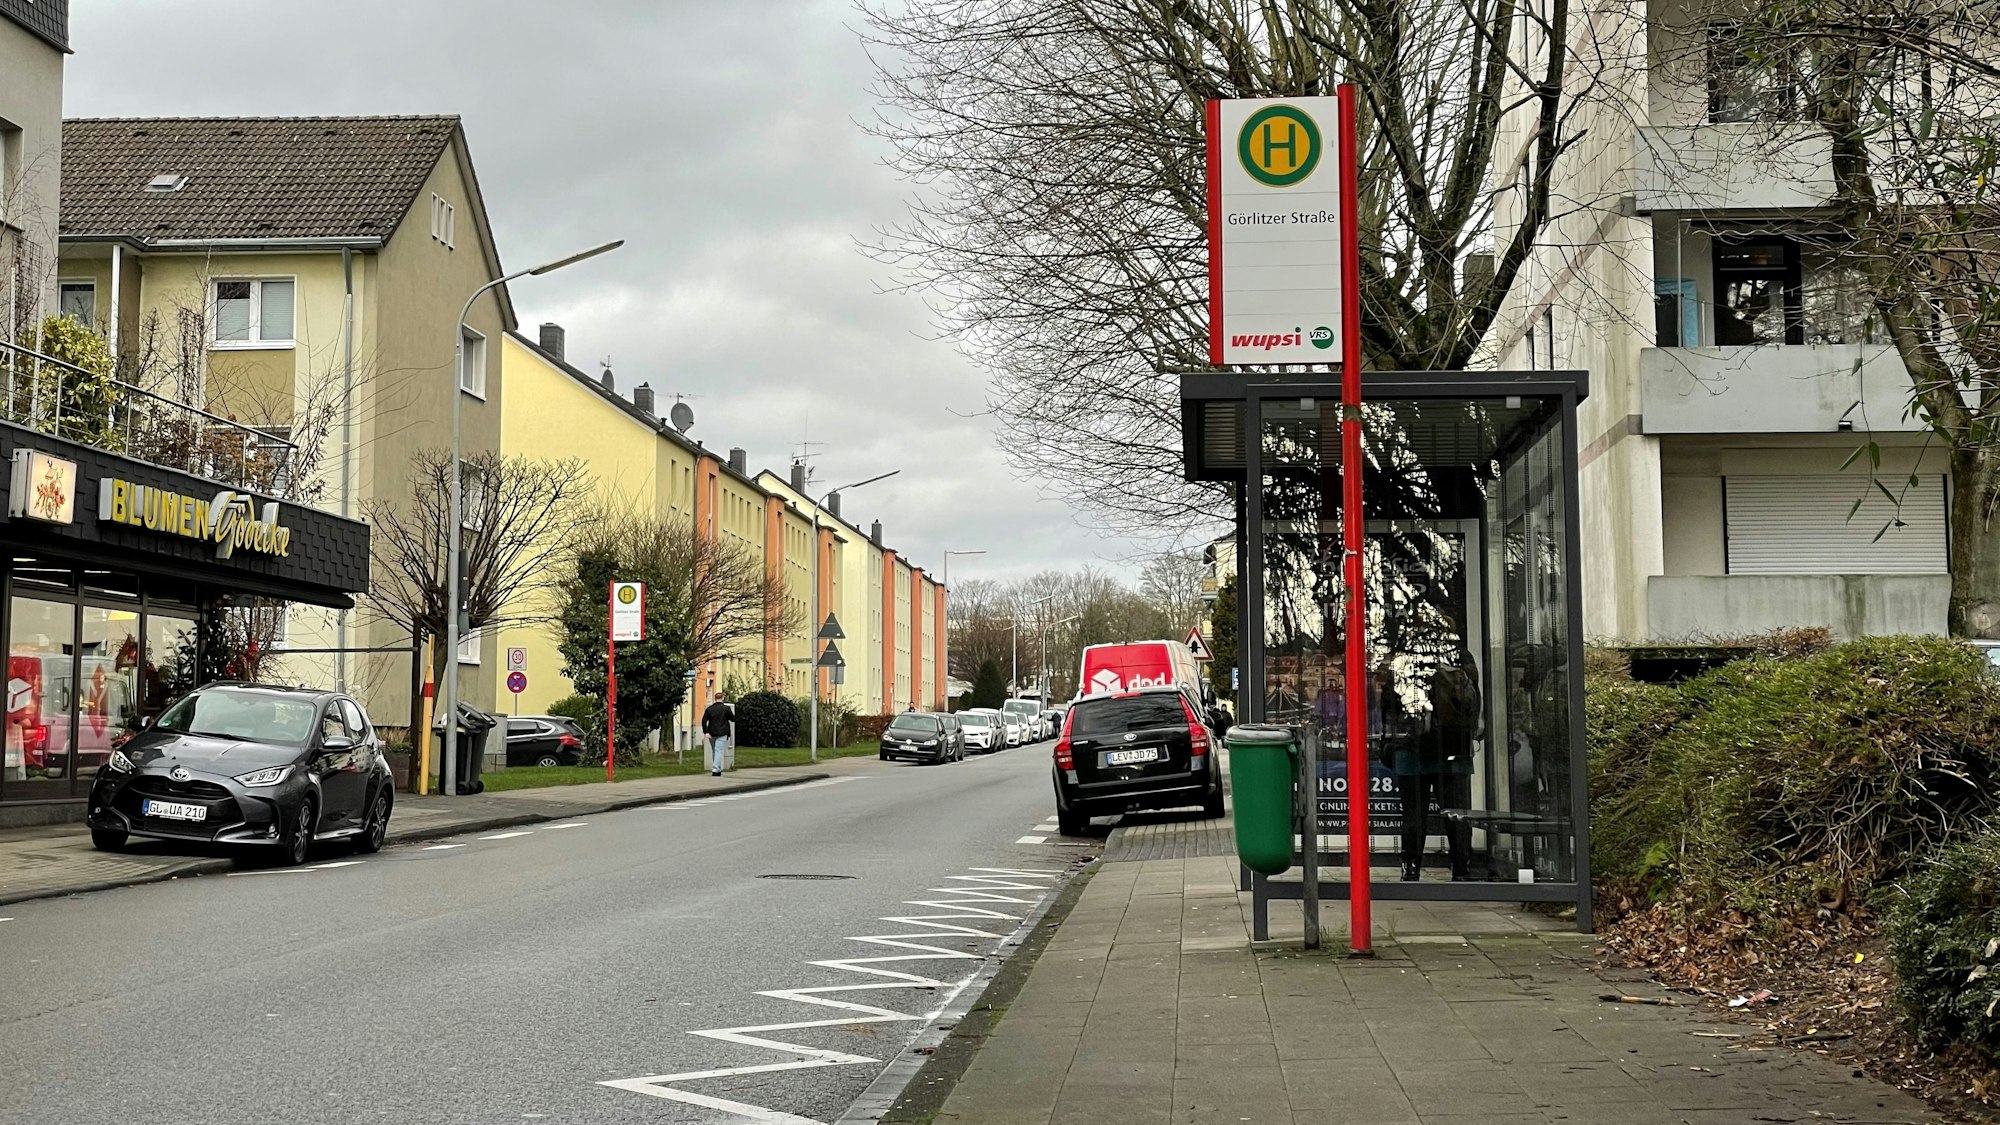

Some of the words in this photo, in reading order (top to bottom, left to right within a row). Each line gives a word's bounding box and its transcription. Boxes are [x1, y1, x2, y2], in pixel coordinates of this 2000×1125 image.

[1264, 124, 1297, 168] H
[1228, 212, 1287, 226] Görlitzer
[1291, 210, 1335, 224] Straße
[1232, 326, 1302, 351] wupsi
[1309, 330, 1328, 339] VRS
[110, 479, 210, 541] BLUMEN
[1113, 753, 1130, 762] LEV
[1134, 750, 1145, 760] JD
[1146, 749, 1157, 758] 75
[1319, 777, 1349, 793] NO
[149, 802, 163, 814] GL
[169, 804, 182, 816] UA
[185, 806, 205, 818] 210
